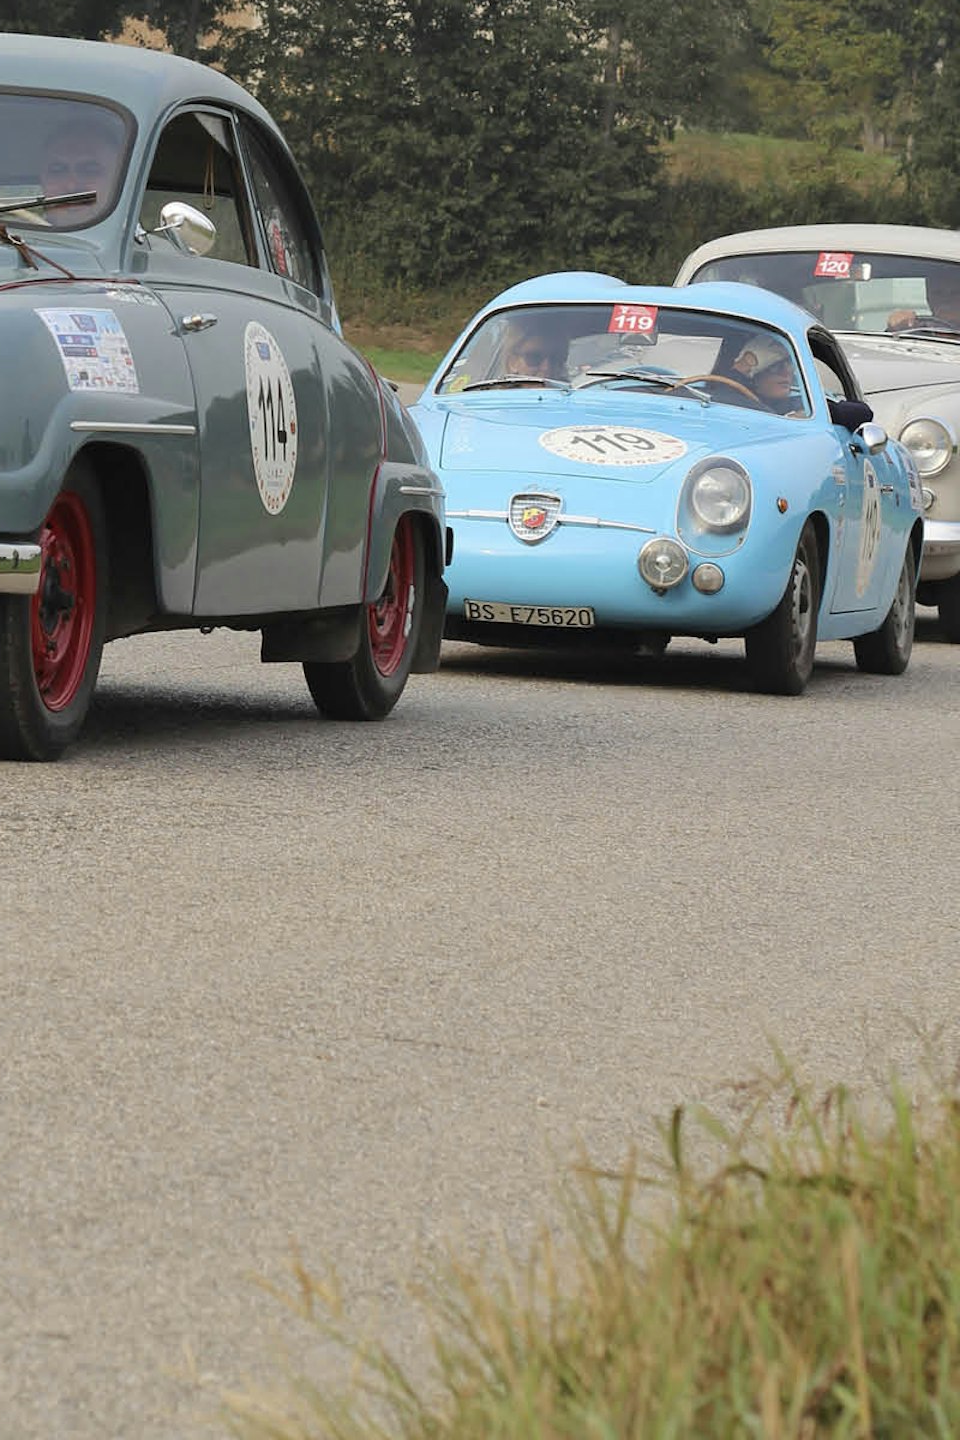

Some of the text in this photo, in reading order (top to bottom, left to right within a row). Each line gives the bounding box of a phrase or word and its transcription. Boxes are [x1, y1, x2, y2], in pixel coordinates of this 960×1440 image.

[818, 261, 849, 273] 120
[614, 314, 653, 330] 119
[258, 374, 287, 461] 114
[570, 432, 656, 454] 119
